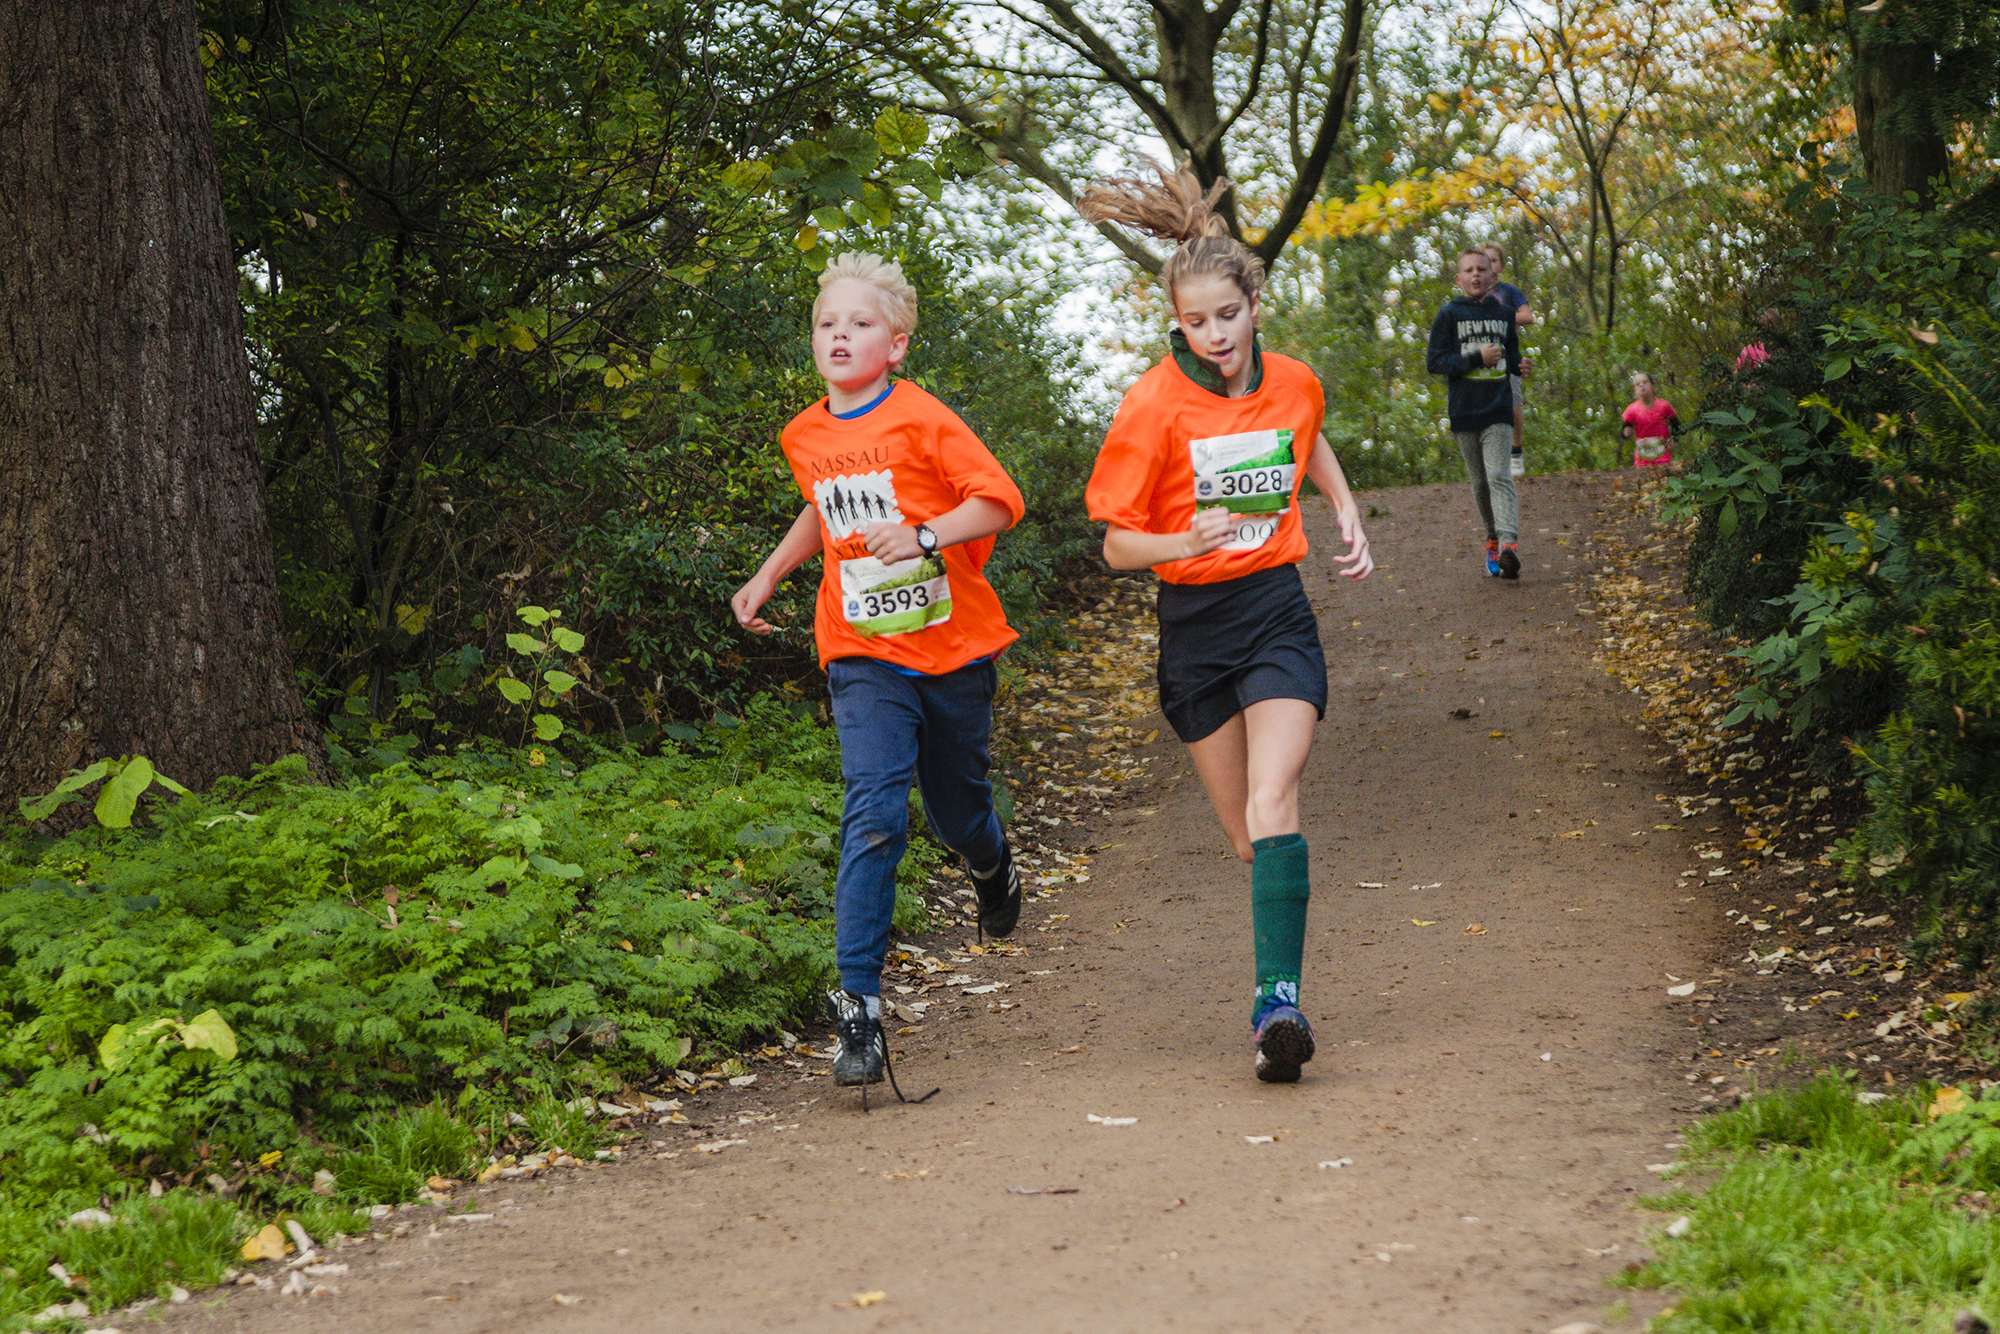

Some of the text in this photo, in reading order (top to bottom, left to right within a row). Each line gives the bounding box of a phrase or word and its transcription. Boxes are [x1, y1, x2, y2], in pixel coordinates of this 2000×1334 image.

[1457, 320, 1483, 339] NEW
[810, 445, 890, 478] NASSAU
[1221, 469, 1282, 496] 3028
[1239, 522, 1276, 542] OO
[835, 542, 869, 560] SH
[864, 585, 930, 618] 3593
